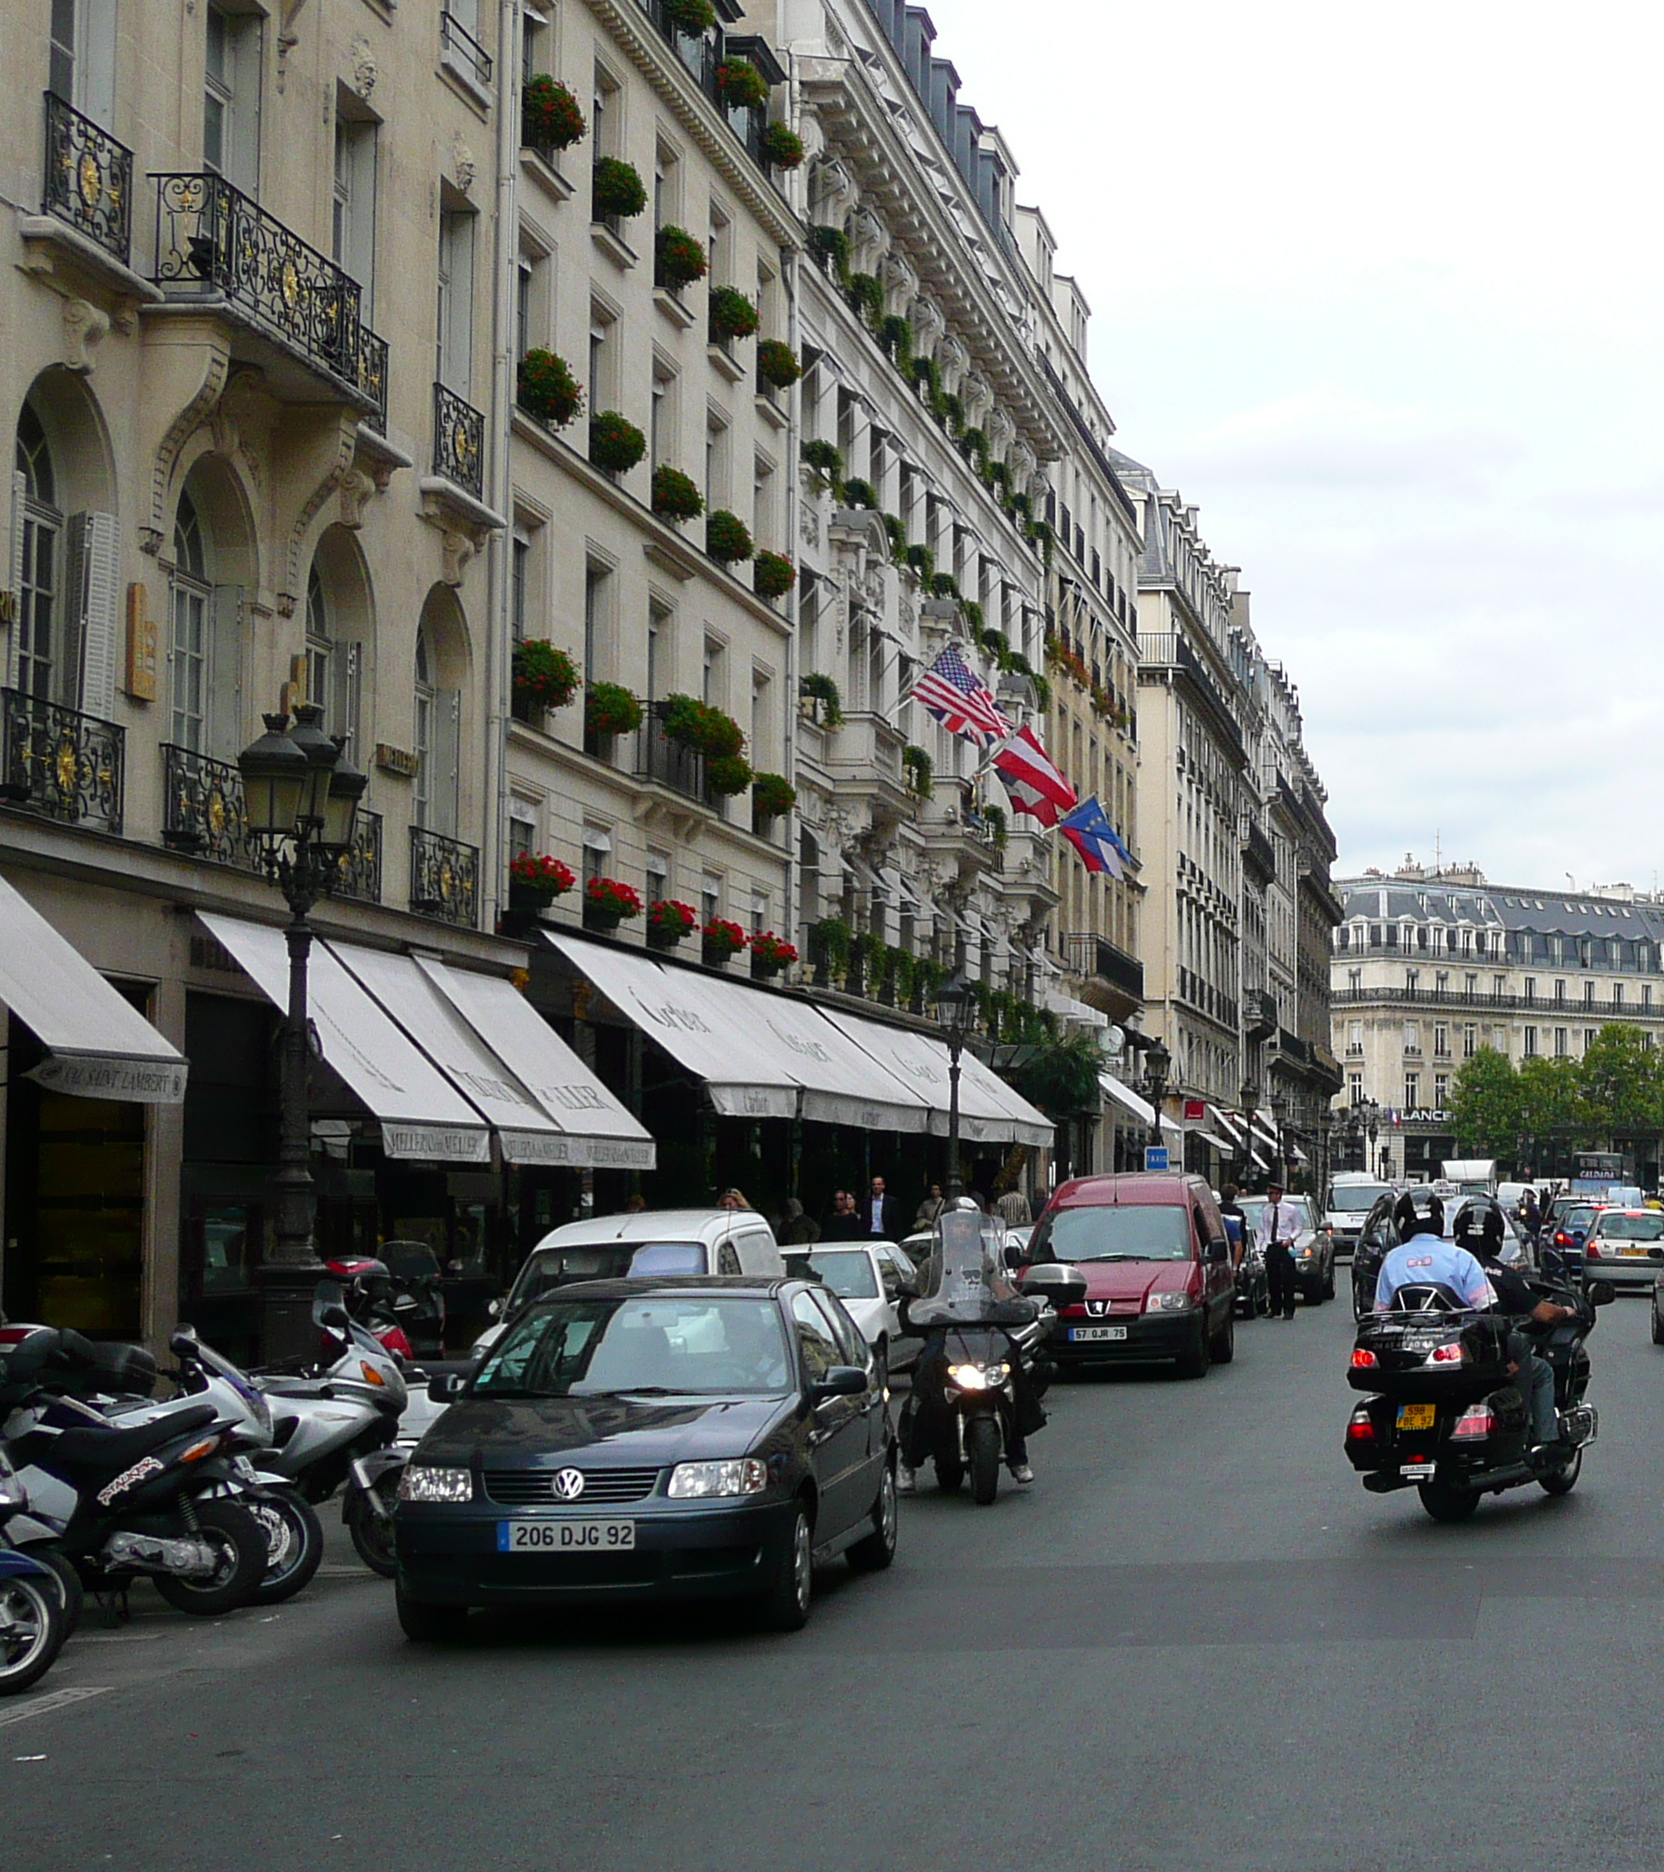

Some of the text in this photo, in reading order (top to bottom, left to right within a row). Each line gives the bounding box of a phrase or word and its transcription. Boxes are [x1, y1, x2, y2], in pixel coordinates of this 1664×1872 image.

[121, 1071, 170, 1093] LAMBERT
[1076, 1330, 1087, 1339] 57
[1113, 1328, 1125, 1338] 75
[516, 1525, 633, 1546] 206 DJG 92
